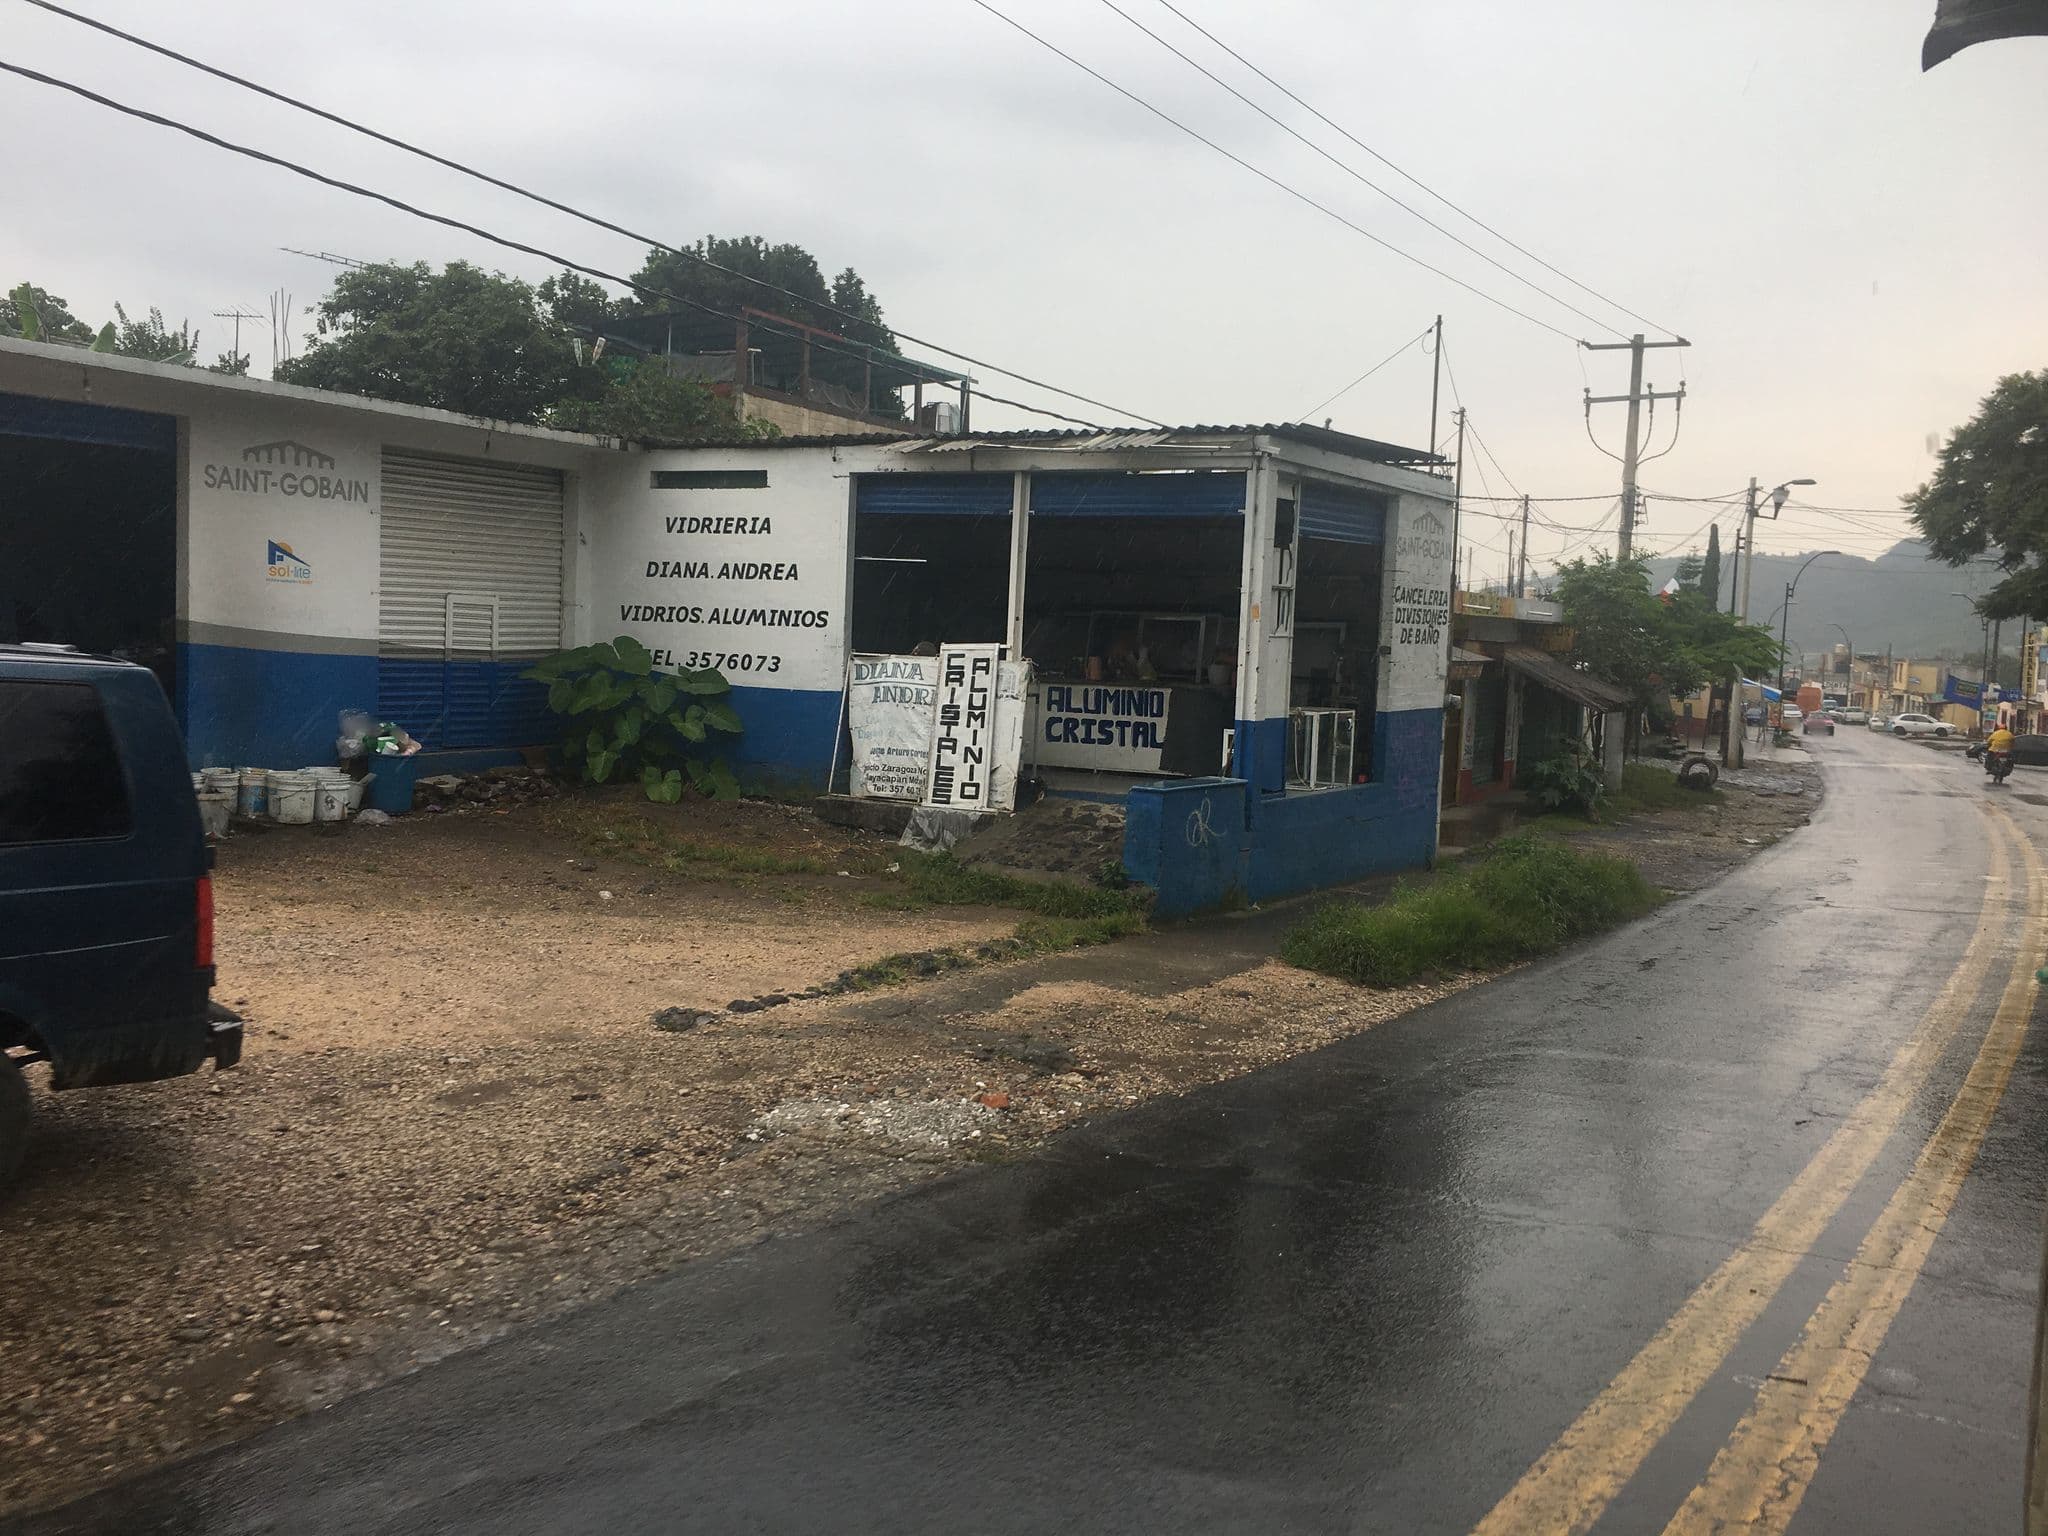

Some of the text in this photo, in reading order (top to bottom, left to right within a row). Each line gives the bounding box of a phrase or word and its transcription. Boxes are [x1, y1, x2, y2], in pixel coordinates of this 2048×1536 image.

[204, 464, 368, 503] SAINT-GOBAIN
[665, 516, 772, 535] VIDRIERIA
[1394, 586, 1448, 607] CANCELERIA
[1395, 607, 1448, 626] DIVISIONES
[1400, 624, 1440, 645] DE BAÑO
[854, 662, 924, 681] DIANA
[1047, 686, 1164, 718] ALUMINIO
[931, 653, 966, 805] CRISTALES
[959, 657, 991, 800] ALUMINIO
[1045, 716, 1163, 749] CRISTAL
[889, 785, 905, 794] 357
